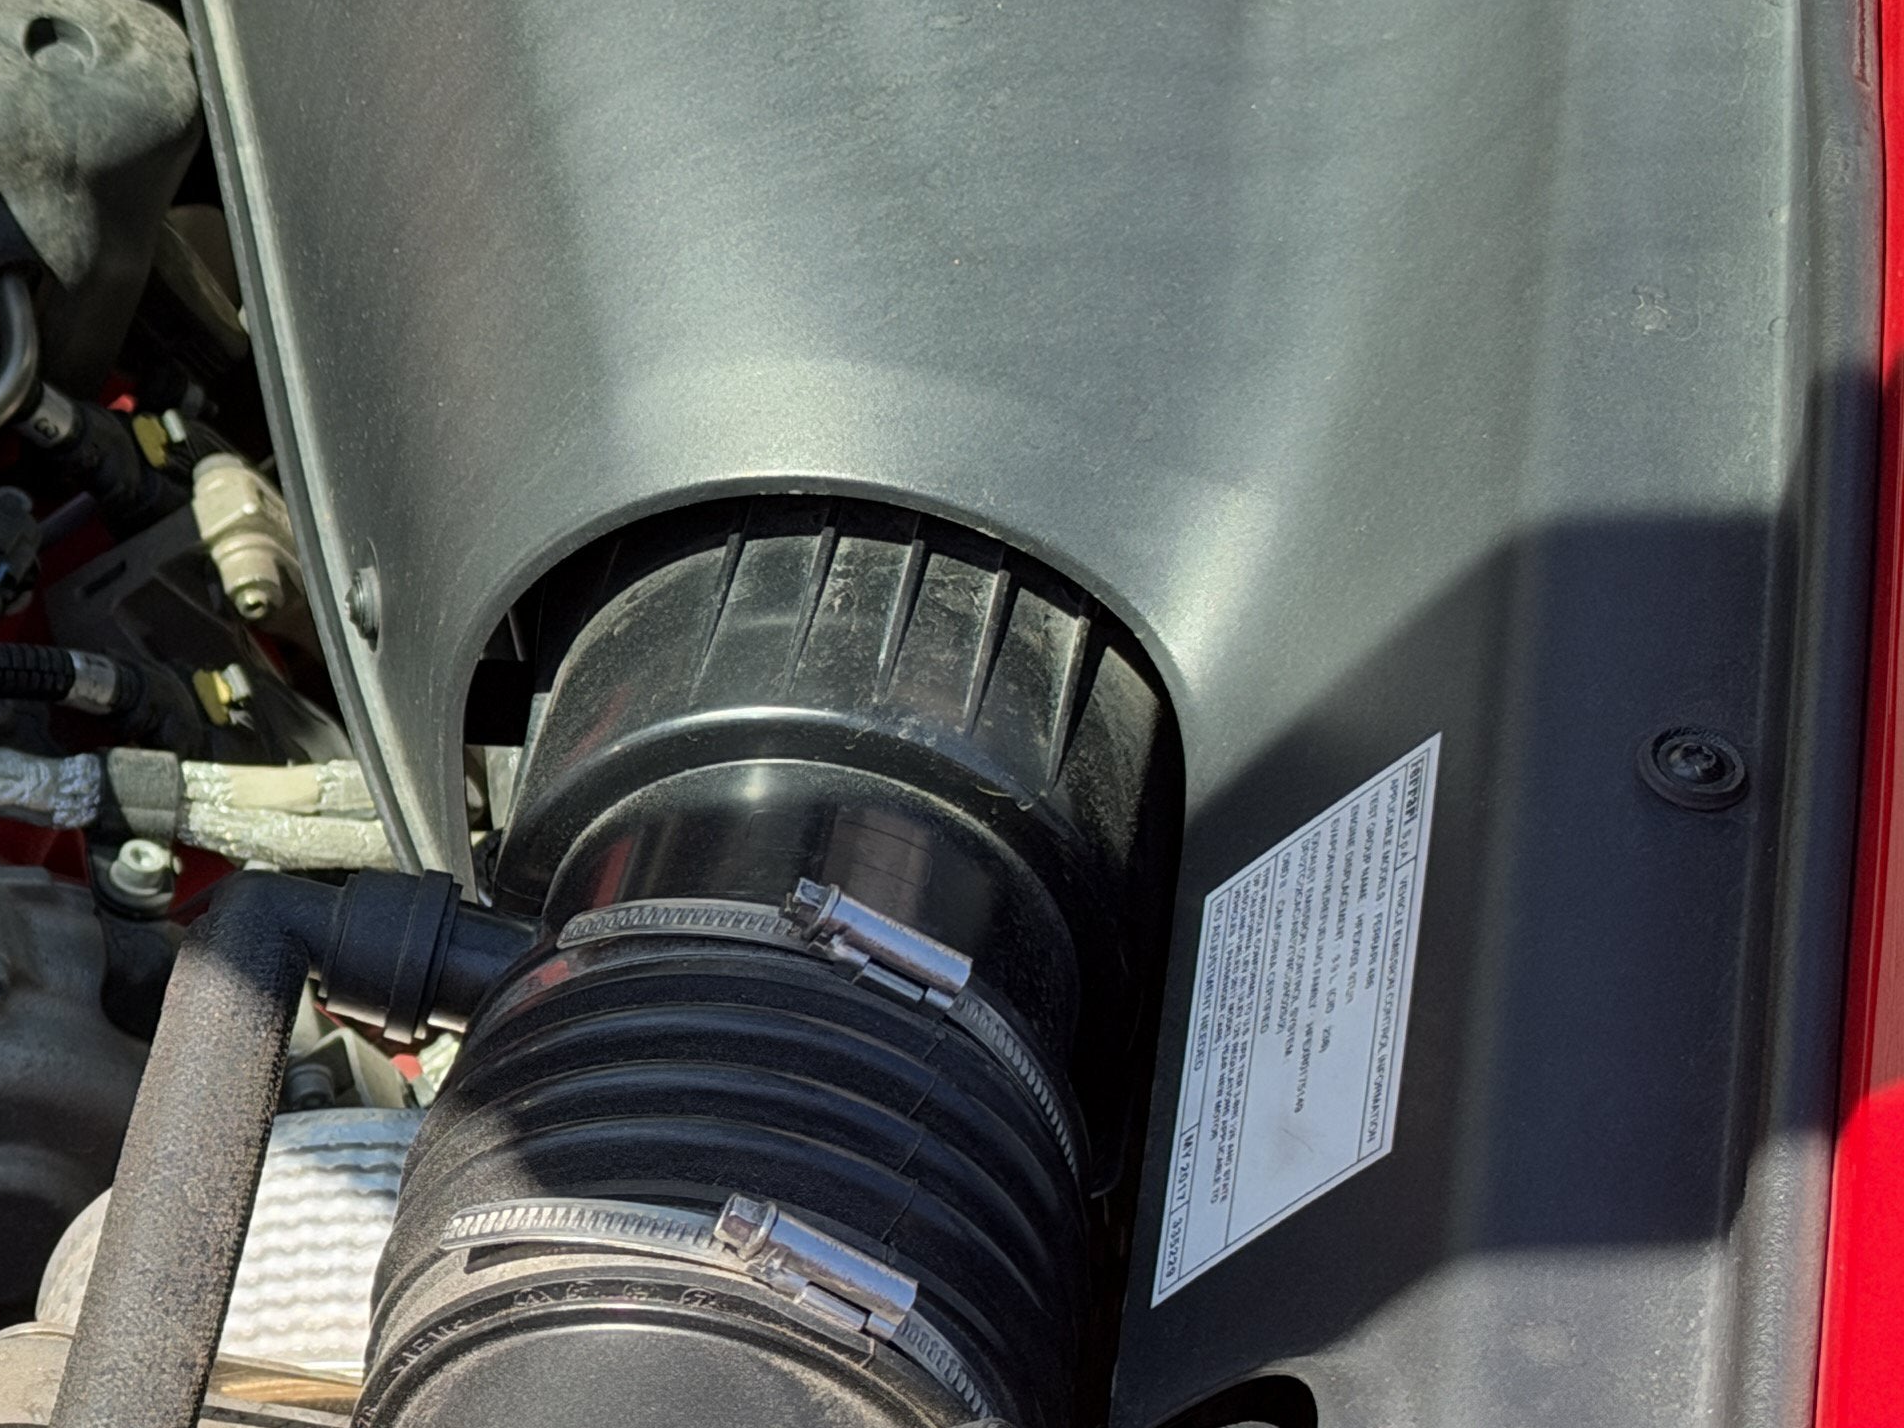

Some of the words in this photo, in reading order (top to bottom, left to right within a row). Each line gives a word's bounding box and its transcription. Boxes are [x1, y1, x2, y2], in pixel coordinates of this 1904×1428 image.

[1367, 789, 1380, 820] TEST
[1382, 778, 1399, 849] APPLICABLE
[1403, 756, 1425, 826] Ferrari
[1346, 804, 1360, 850] ENGINE
[1362, 822, 1376, 864] GROUP
[1280, 852, 1292, 879] OBD
[1306, 830, 1322, 884] EXHAUST
[1358, 866, 1370, 902] NAME
[1375, 849, 1391, 902] MODELS
[1213, 899, 1225, 922] NO
[1244, 890, 1259, 952] CALIFORNIA
[1255, 893, 1267, 936] VEHICLE
[1299, 886, 1314, 945] EMISSION
[1335, 850, 1354, 941] DISPLACEMENT
[1393, 875, 1408, 929] VEHICLE
[1268, 899, 1286, 970] CALIFORNIA
[1368, 912, 1383, 966] FERRARI
[1386, 928, 1402, 991] EMISSION
[1202, 924, 1221, 1012] ADJUSTMENT
[1290, 946, 1306, 1007] CONTROL
[1308, 967, 1322, 1009] FAMILY
[1224, 1002, 1235, 1039] MODEL
[1259, 971, 1276, 1035] CERTIFIED
[1377, 992, 1395, 1054] CONTROL
[1194, 1014, 1210, 1072] NEEDED
[1220, 1042, 1230, 1071] YEAR
[1284, 1006, 1299, 1057] SYSTEM
[1209, 1099, 1223, 1141] MOTOR
[1367, 1054, 1386, 1143] INFORMATION
[1181, 1133, 1194, 1159] MY
[1212, 1119, 1228, 1186] APPLICABLE
[1224, 1143, 1235, 1167] AND
[1176, 1162, 1190, 1201] 2017
[1210, 1187, 1220, 1205] TO
[1165, 1217, 1183, 1278] 335229
